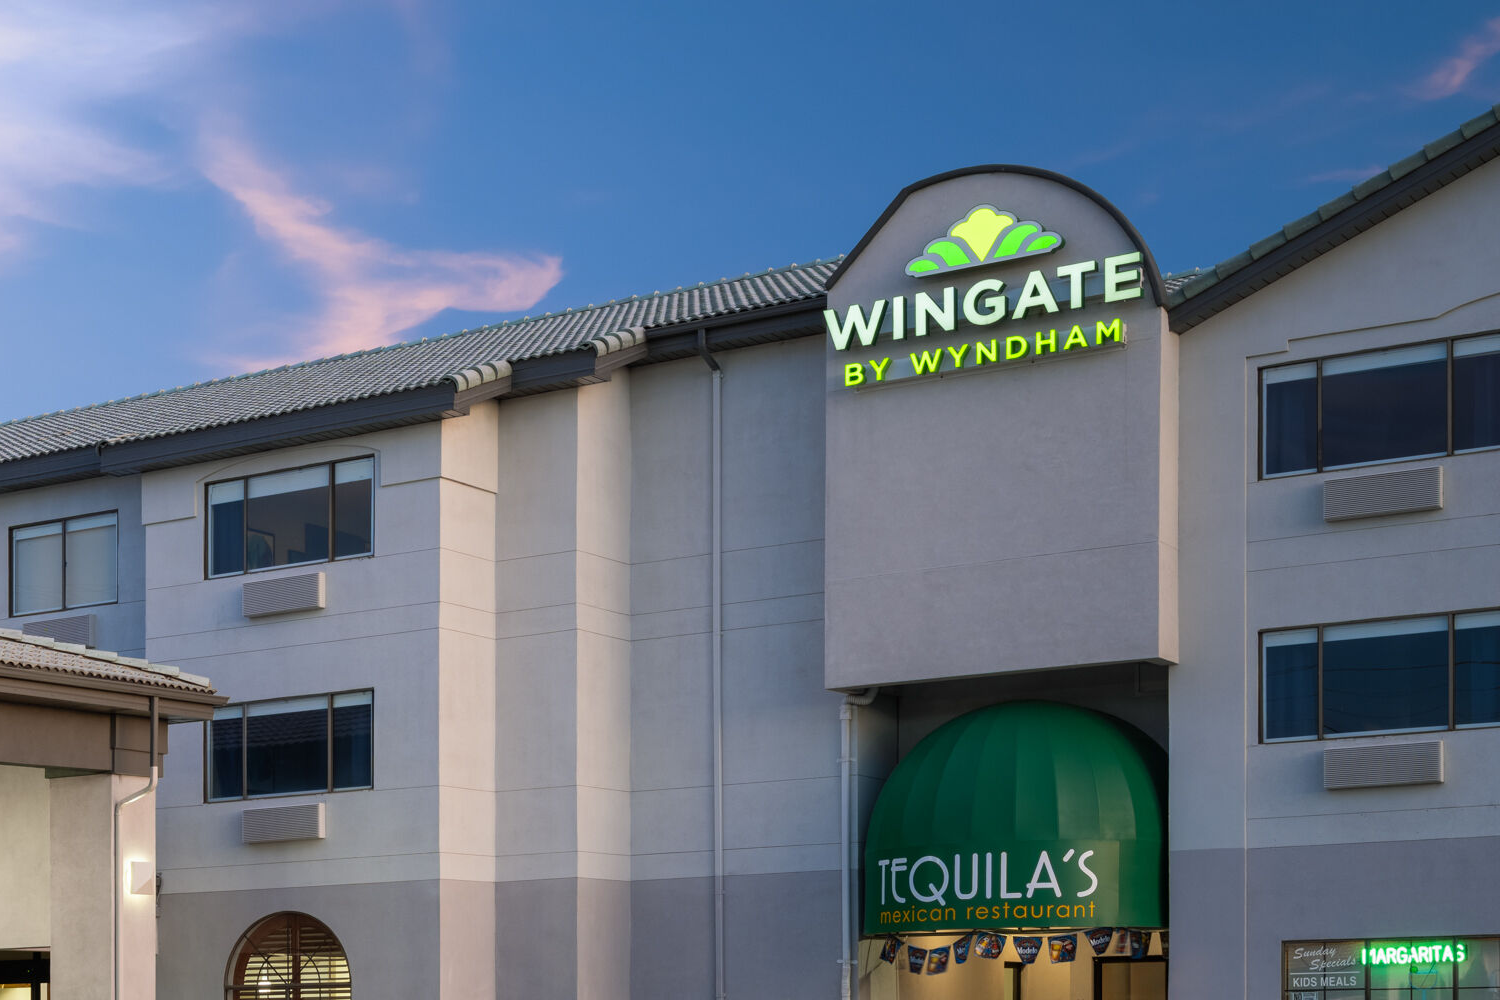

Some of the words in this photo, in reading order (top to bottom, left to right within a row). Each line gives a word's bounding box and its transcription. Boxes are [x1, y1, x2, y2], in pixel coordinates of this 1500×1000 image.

[823, 251, 1144, 351] WINGATE
[844, 357, 891, 387] BY
[910, 318, 1124, 376] WYNDHAM
[878, 848, 1098, 906] TEQUILA'S
[880, 905, 956, 924] mexican
[966, 901, 1096, 920] restaurant
[1016, 946, 1038, 954] Modelo
[1090, 935, 1111, 946] Modelo
[1293, 946, 1337, 960] Sunday
[1361, 943, 1467, 965] MARGARITAS
[1309, 955, 1357, 972] Specials
[1292, 976, 1318, 988] KIDS
[1320, 975, 1357, 987] MEALS
